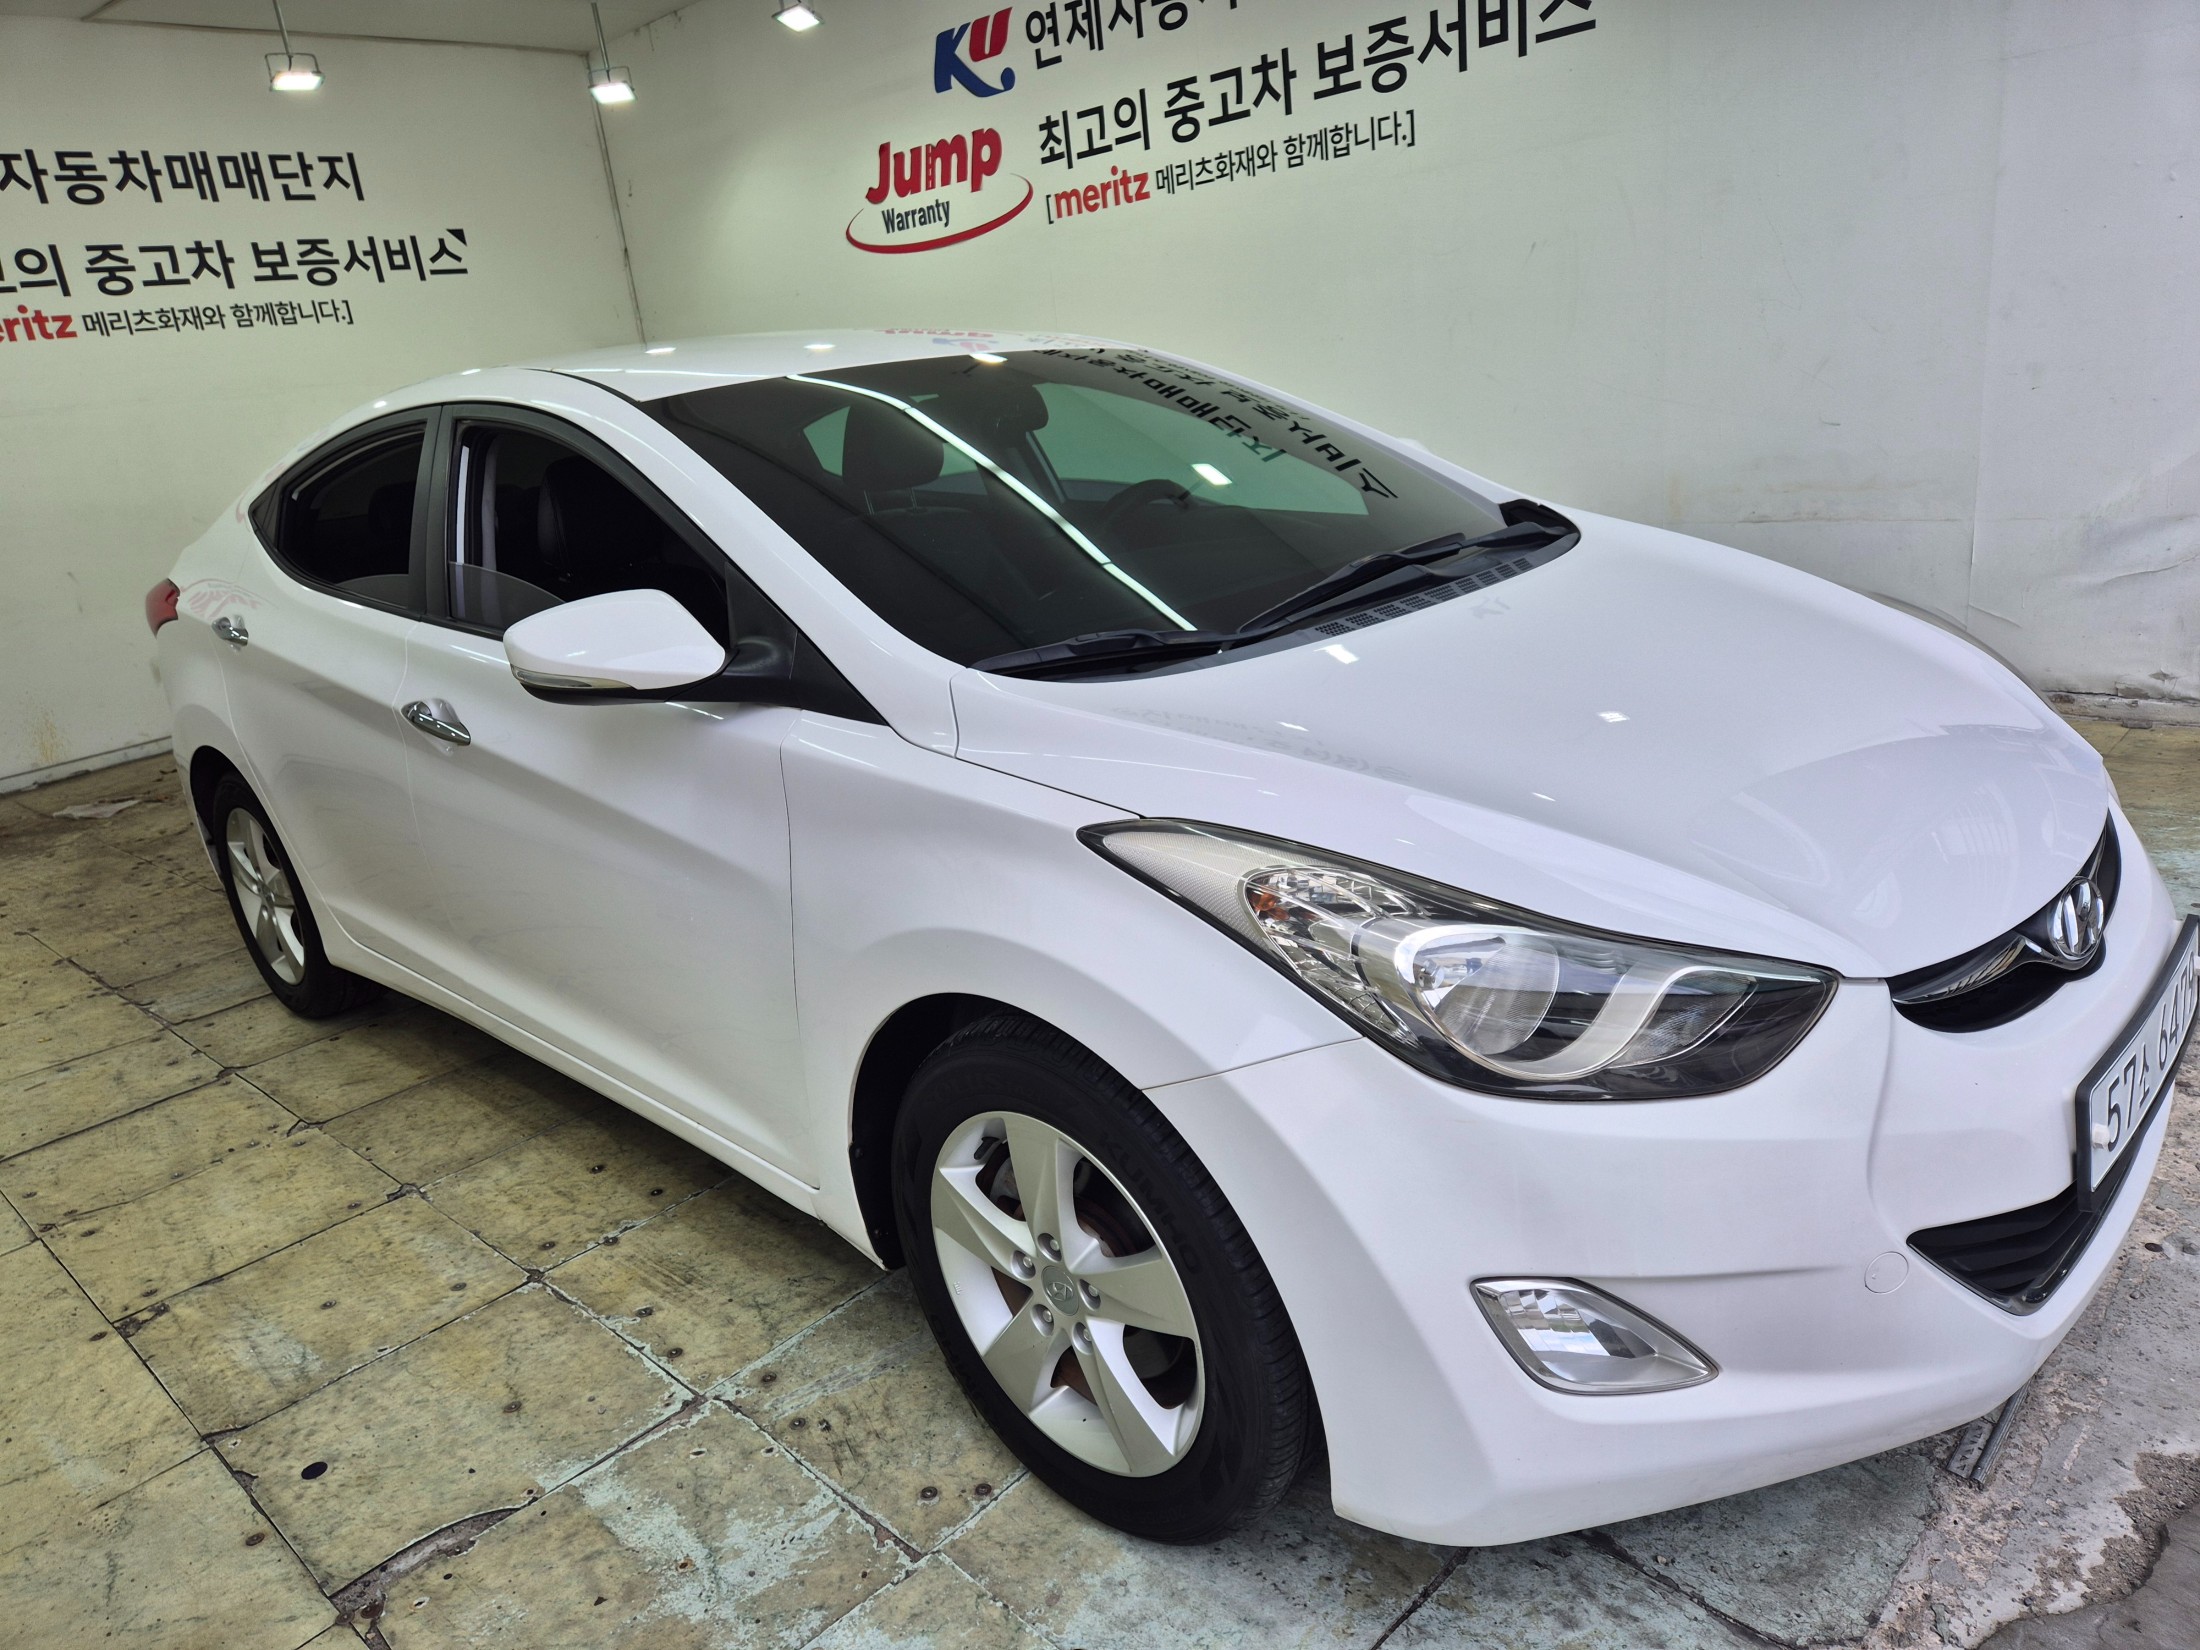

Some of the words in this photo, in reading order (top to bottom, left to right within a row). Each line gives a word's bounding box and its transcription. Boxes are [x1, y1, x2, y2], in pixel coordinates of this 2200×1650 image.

[1025, 0, 1238, 70] 연제자
[1039, 88, 1151, 170] 최고의
[1163, 47, 1298, 144] 중고차
[1313, 0, 1597, 101] 보증서비스
[0, 148, 365, 206] 자동차매매단지
[865, 127, 1003, 205] Jump
[1154, 139, 1279, 196] 메리츠화재와
[881, 198, 951, 235] Warranty
[84, 240, 236, 297] 중고차
[252, 235, 469, 288] 보증서비스
[81, 304, 227, 339] 메리츠화재와
[1100, 1131, 1203, 1276] KUMHO
